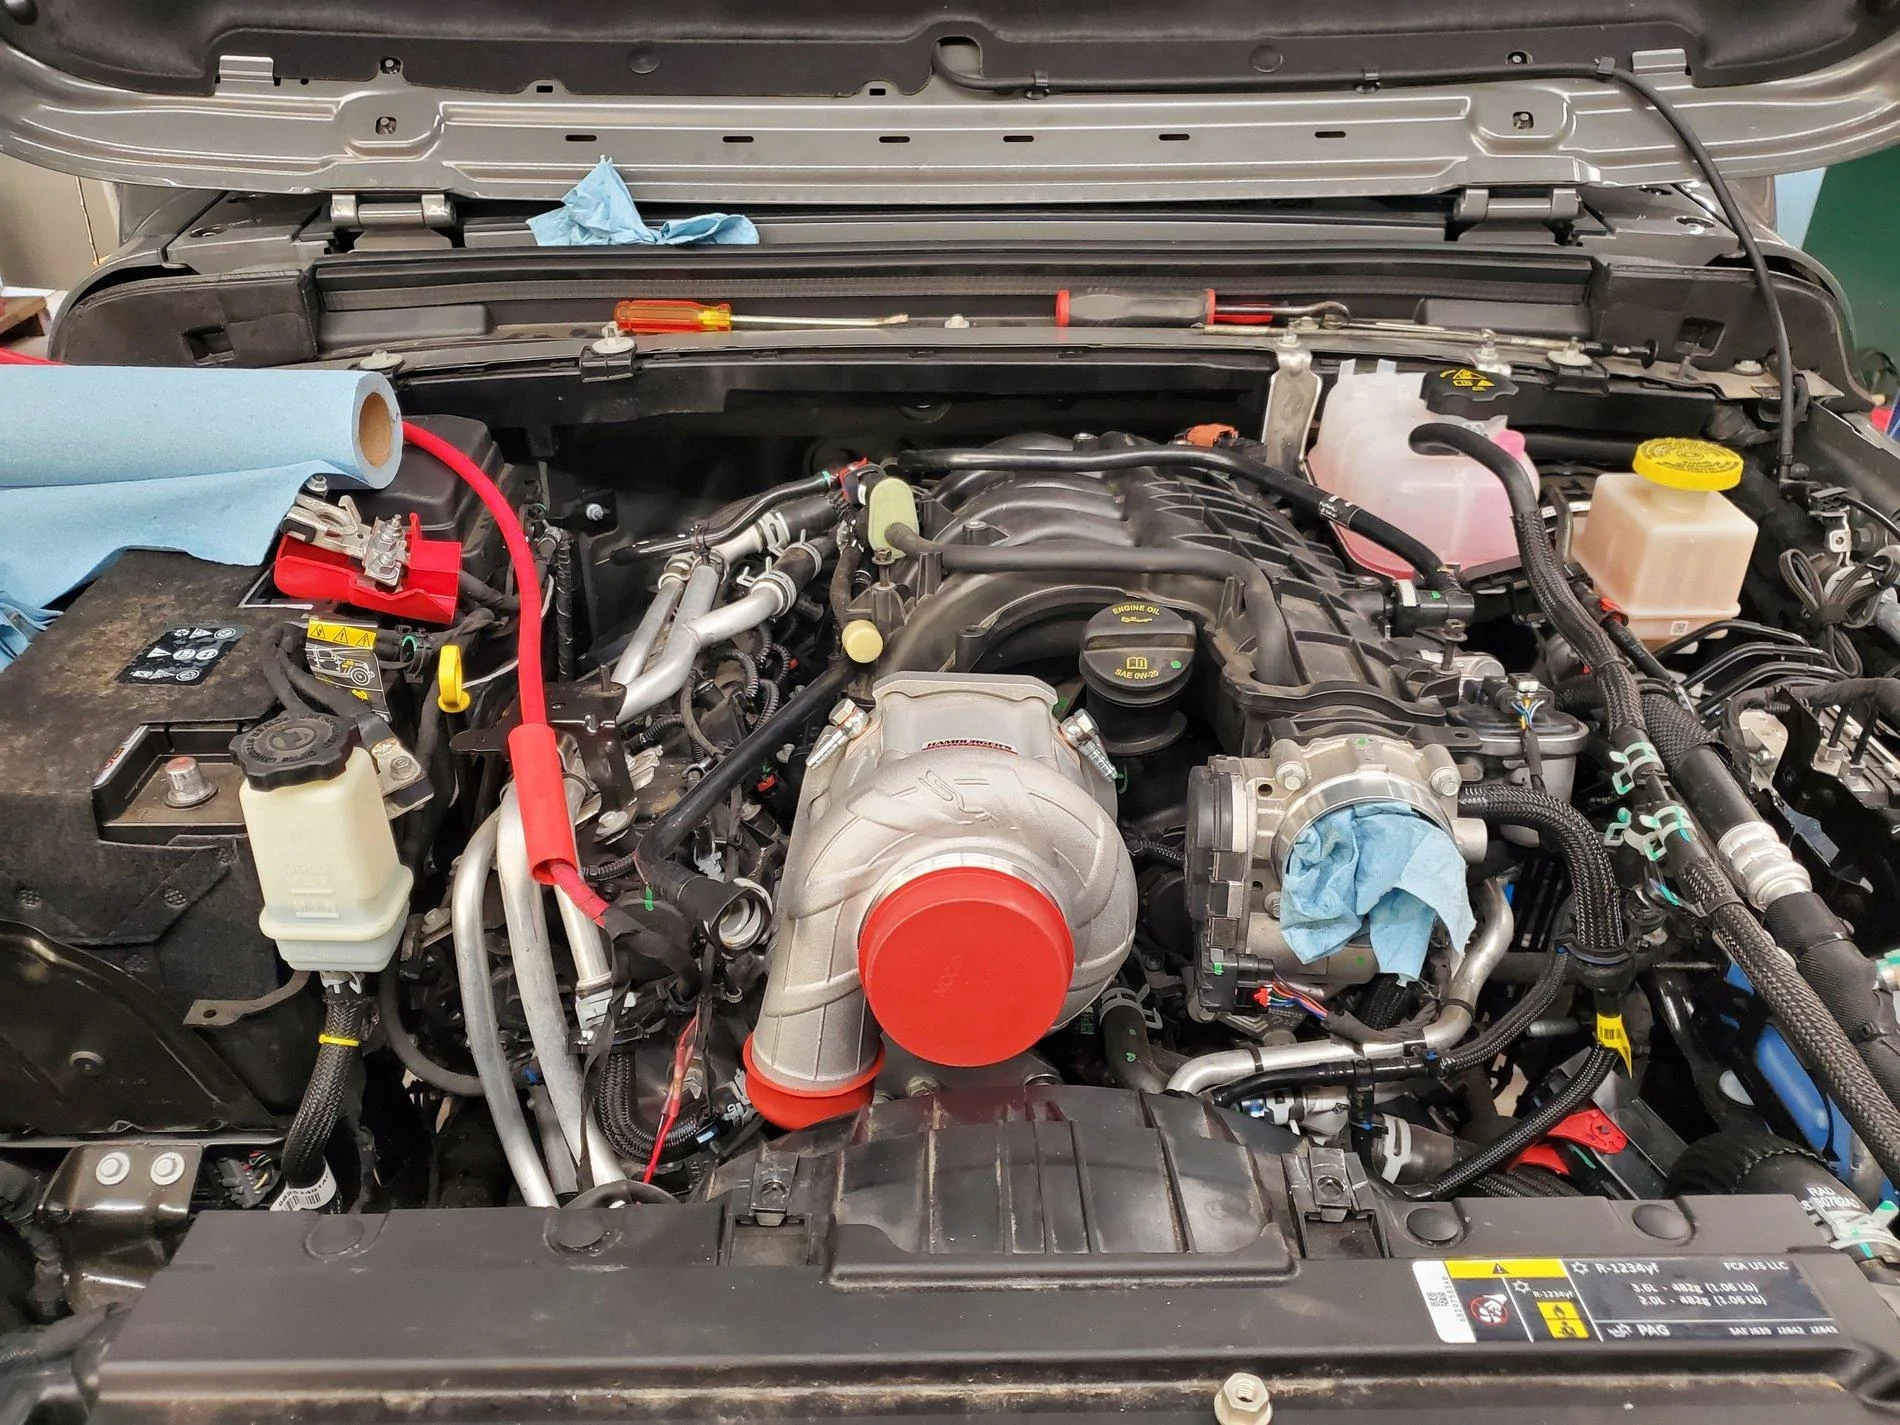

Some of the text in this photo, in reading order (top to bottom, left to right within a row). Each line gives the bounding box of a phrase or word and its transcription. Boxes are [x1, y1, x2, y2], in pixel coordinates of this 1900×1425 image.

[1112, 604, 1160, 616] ENGINE OIL
[1115, 668, 1160, 680] SAE 0W-20
[1807, 1186, 1836, 1197] RAD
[1594, 1262, 1660, 1275] R-1234yf
[1723, 1261, 1790, 1270] FCA US LLC
[1630, 1283, 1659, 1293] 3.6L
[1532, 1289, 1575, 1299] R-1234yf
[1637, 1295, 1667, 1305] 2.0L
[1635, 1323, 1671, 1336] PAG
